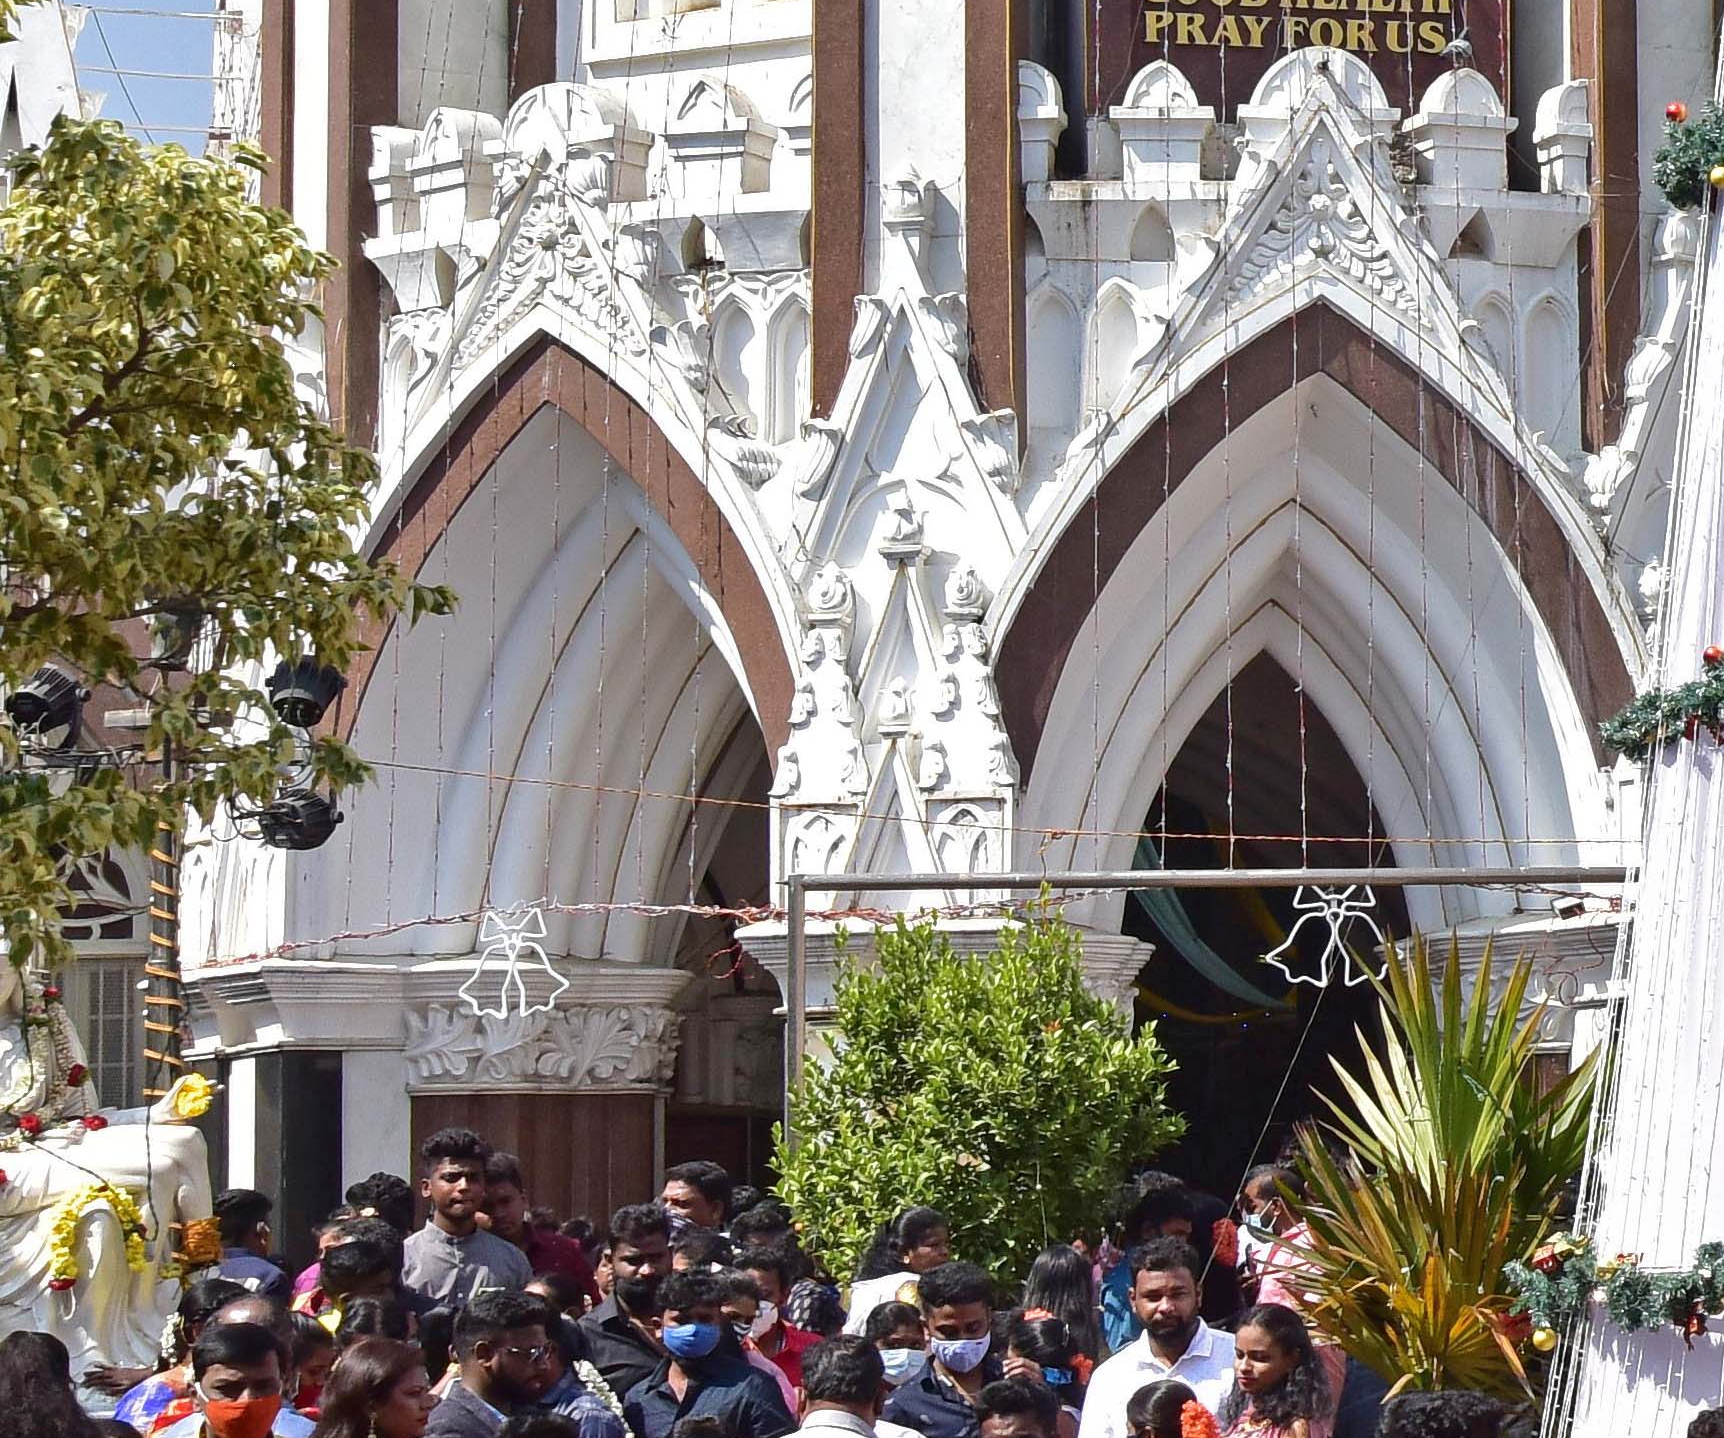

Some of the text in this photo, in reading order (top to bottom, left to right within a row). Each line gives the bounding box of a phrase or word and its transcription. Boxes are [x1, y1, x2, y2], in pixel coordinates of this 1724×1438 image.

[1143, 10, 1448, 54] PRAY FOR US
